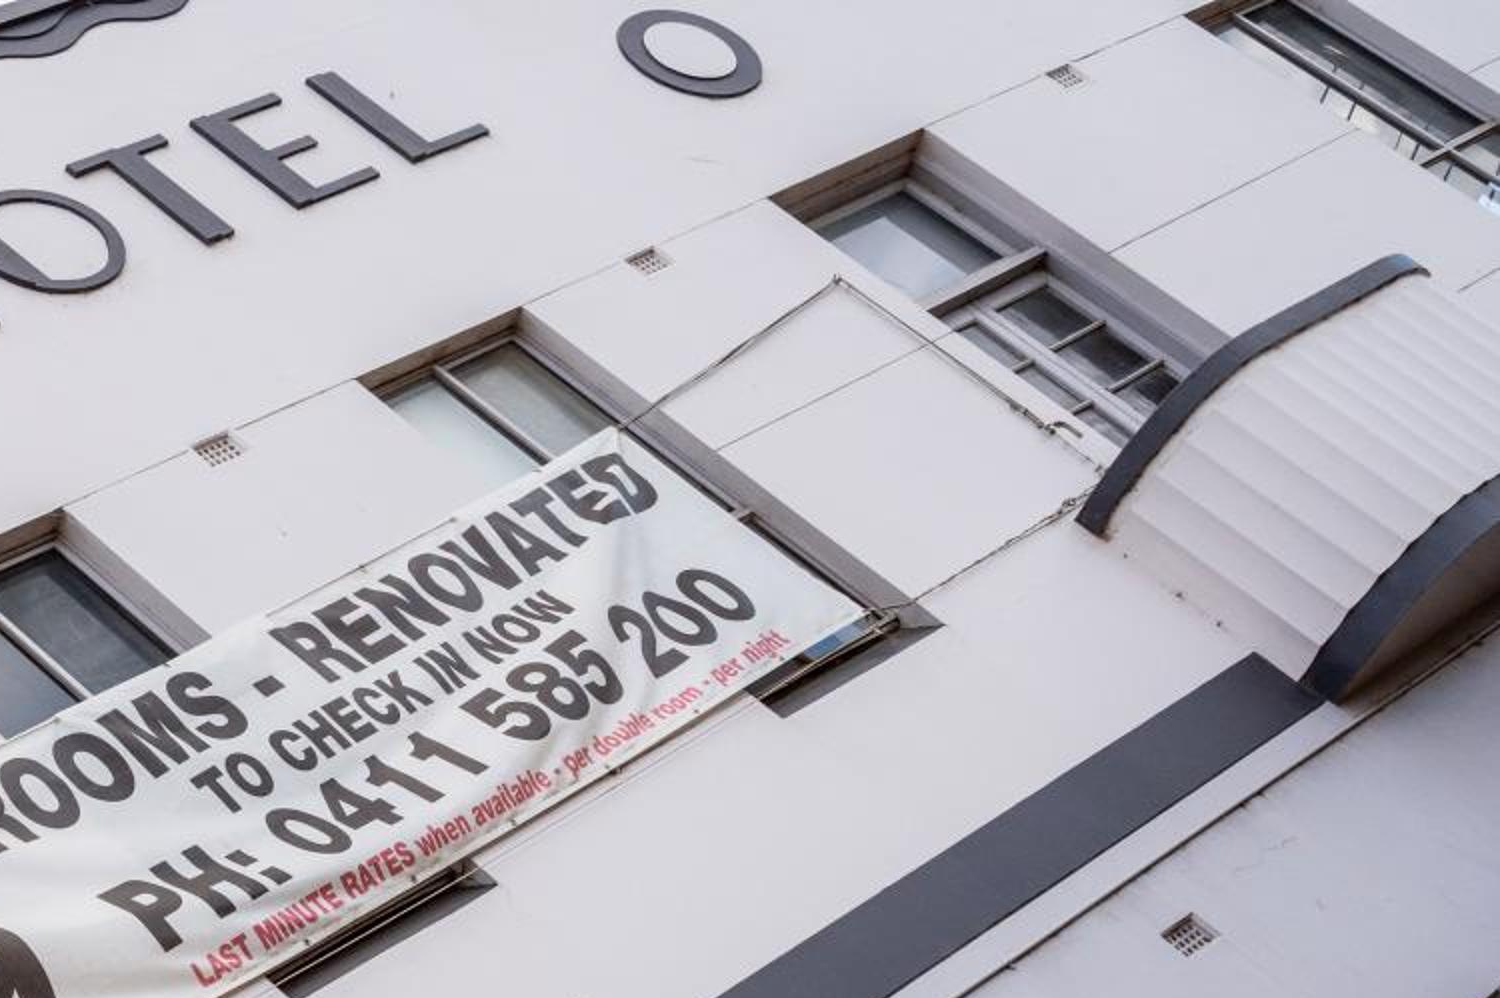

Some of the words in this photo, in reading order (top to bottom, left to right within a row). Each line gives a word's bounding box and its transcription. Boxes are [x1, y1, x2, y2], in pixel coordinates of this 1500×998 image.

[190, 752, 274, 813] TO
[268, 670, 434, 771] CHECK
[413, 641, 481, 695] IN
[463, 590, 576, 664] NOW
[268, 452, 658, 683] RENOVATED
[98, 844, 292, 952] PH:
[265, 731, 489, 854] 0411
[459, 629, 624, 741] 585
[607, 568, 757, 679] 200
[191, 933, 254, 987] LAST
[253, 882, 344, 950] MINUTE
[339, 841, 416, 898] RATES
[414, 814, 470, 856] when
[471, 768, 550, 825] available
[562, 749, 593, 778] per
[592, 711, 653, 756] double
[650, 686, 700, 722] room
[710, 659, 742, 687] per
[741, 629, 790, 660] night
